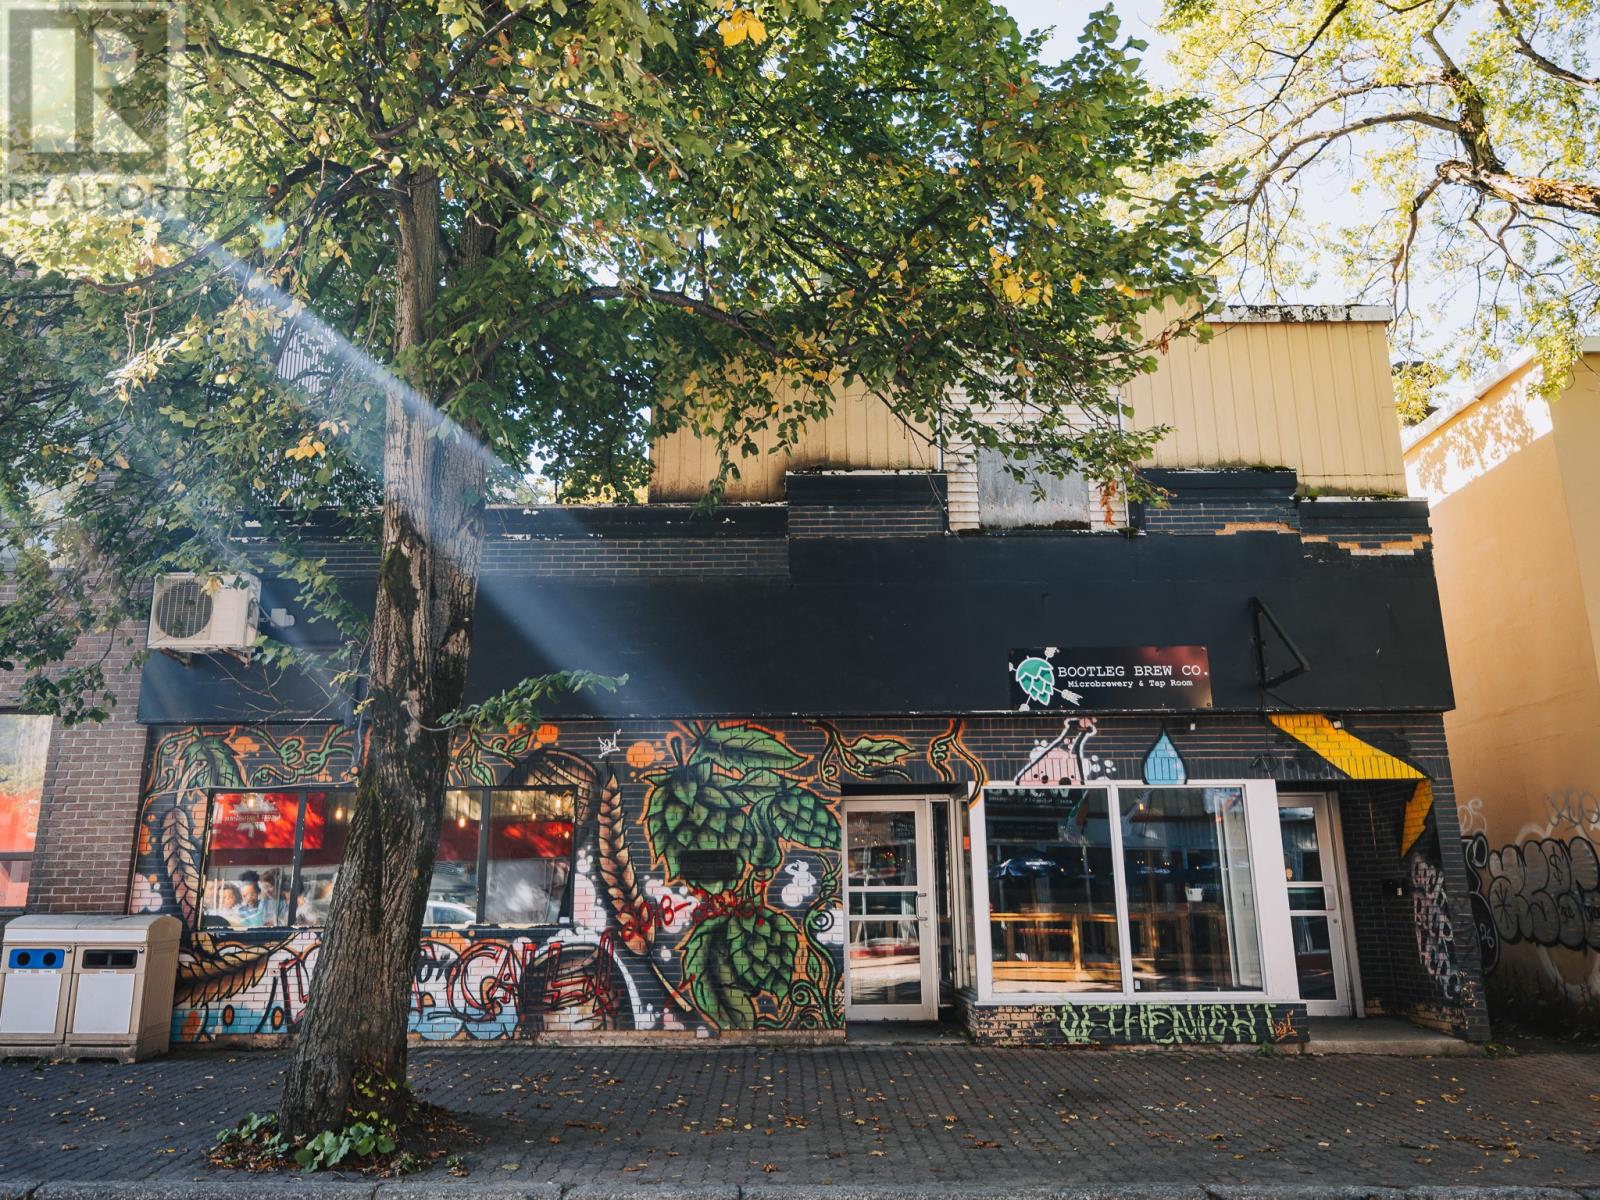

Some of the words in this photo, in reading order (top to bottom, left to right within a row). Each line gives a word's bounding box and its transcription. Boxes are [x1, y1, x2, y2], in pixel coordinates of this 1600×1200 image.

[1057, 665, 1125, 677] BOOTLEG
[1134, 665, 1173, 677] BREW
[1181, 664, 1209, 676] CO.
[1067, 680, 1133, 688] Microbrewery
[1148, 679, 1166, 688] Tap
[1170, 679, 1193, 687] Room
